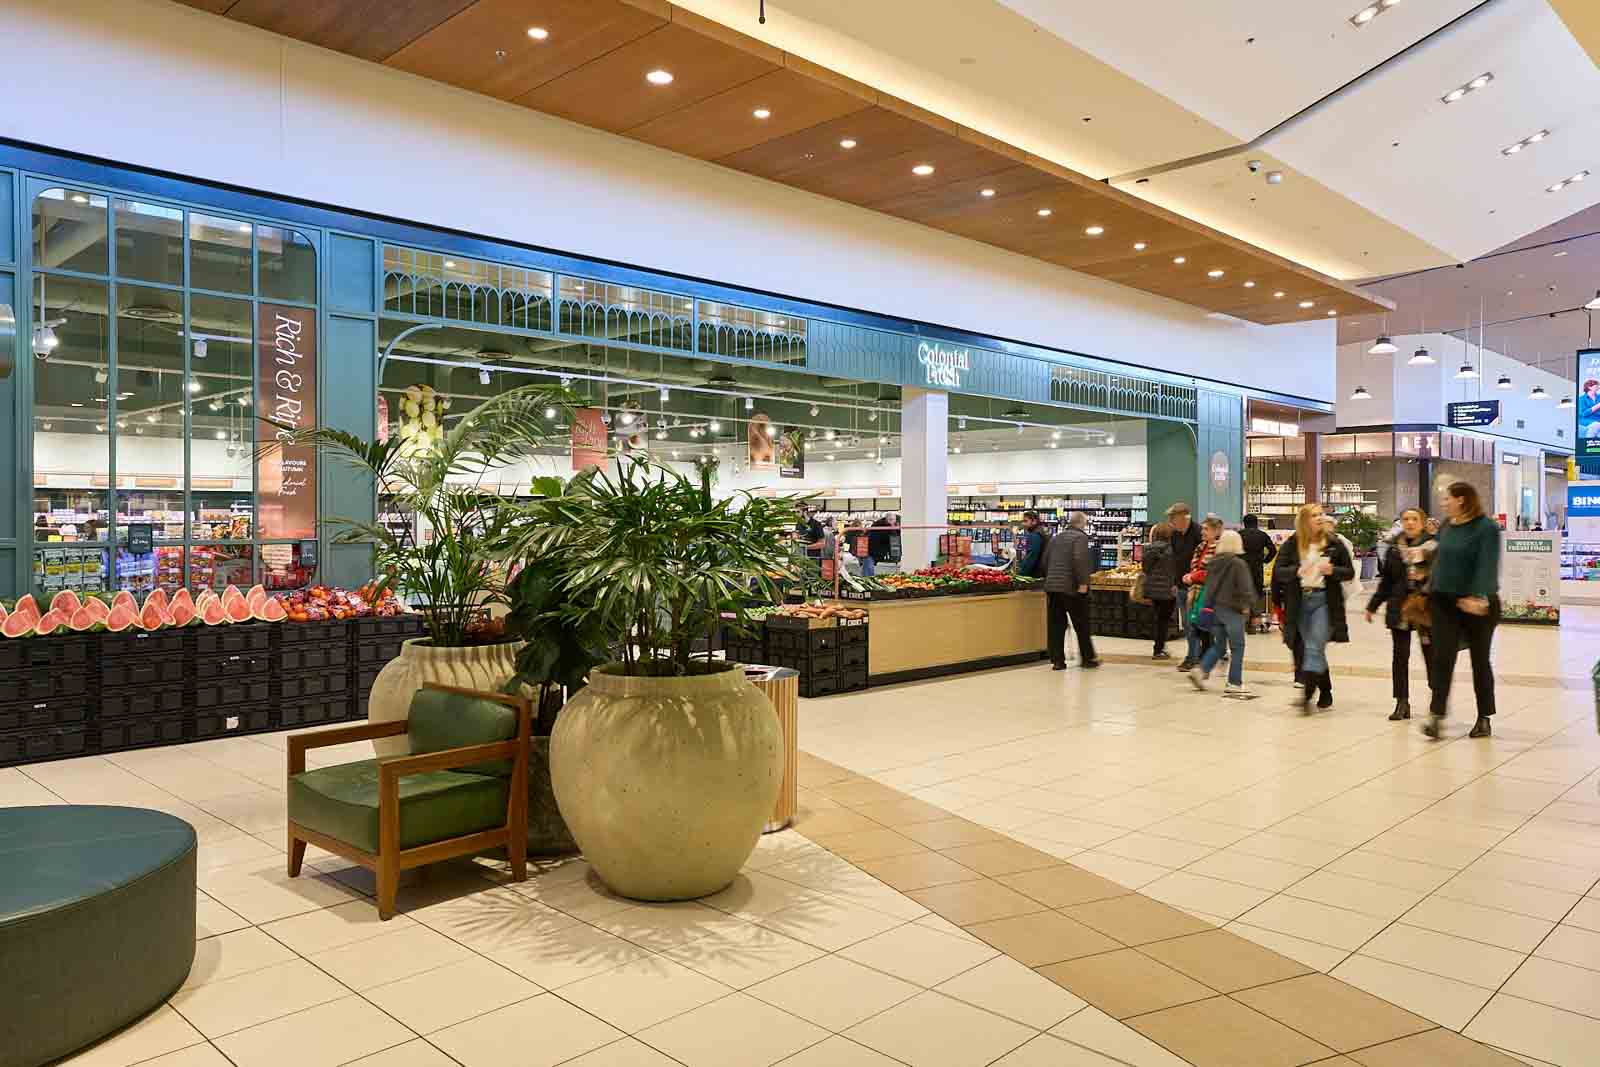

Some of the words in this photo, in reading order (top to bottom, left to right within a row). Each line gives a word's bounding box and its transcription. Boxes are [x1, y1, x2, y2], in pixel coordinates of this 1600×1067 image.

[275, 312, 303, 365] Rich
[918, 342, 970, 371] Colonial
[275, 369, 303, 393] &
[927, 364, 961, 387] Fresh
